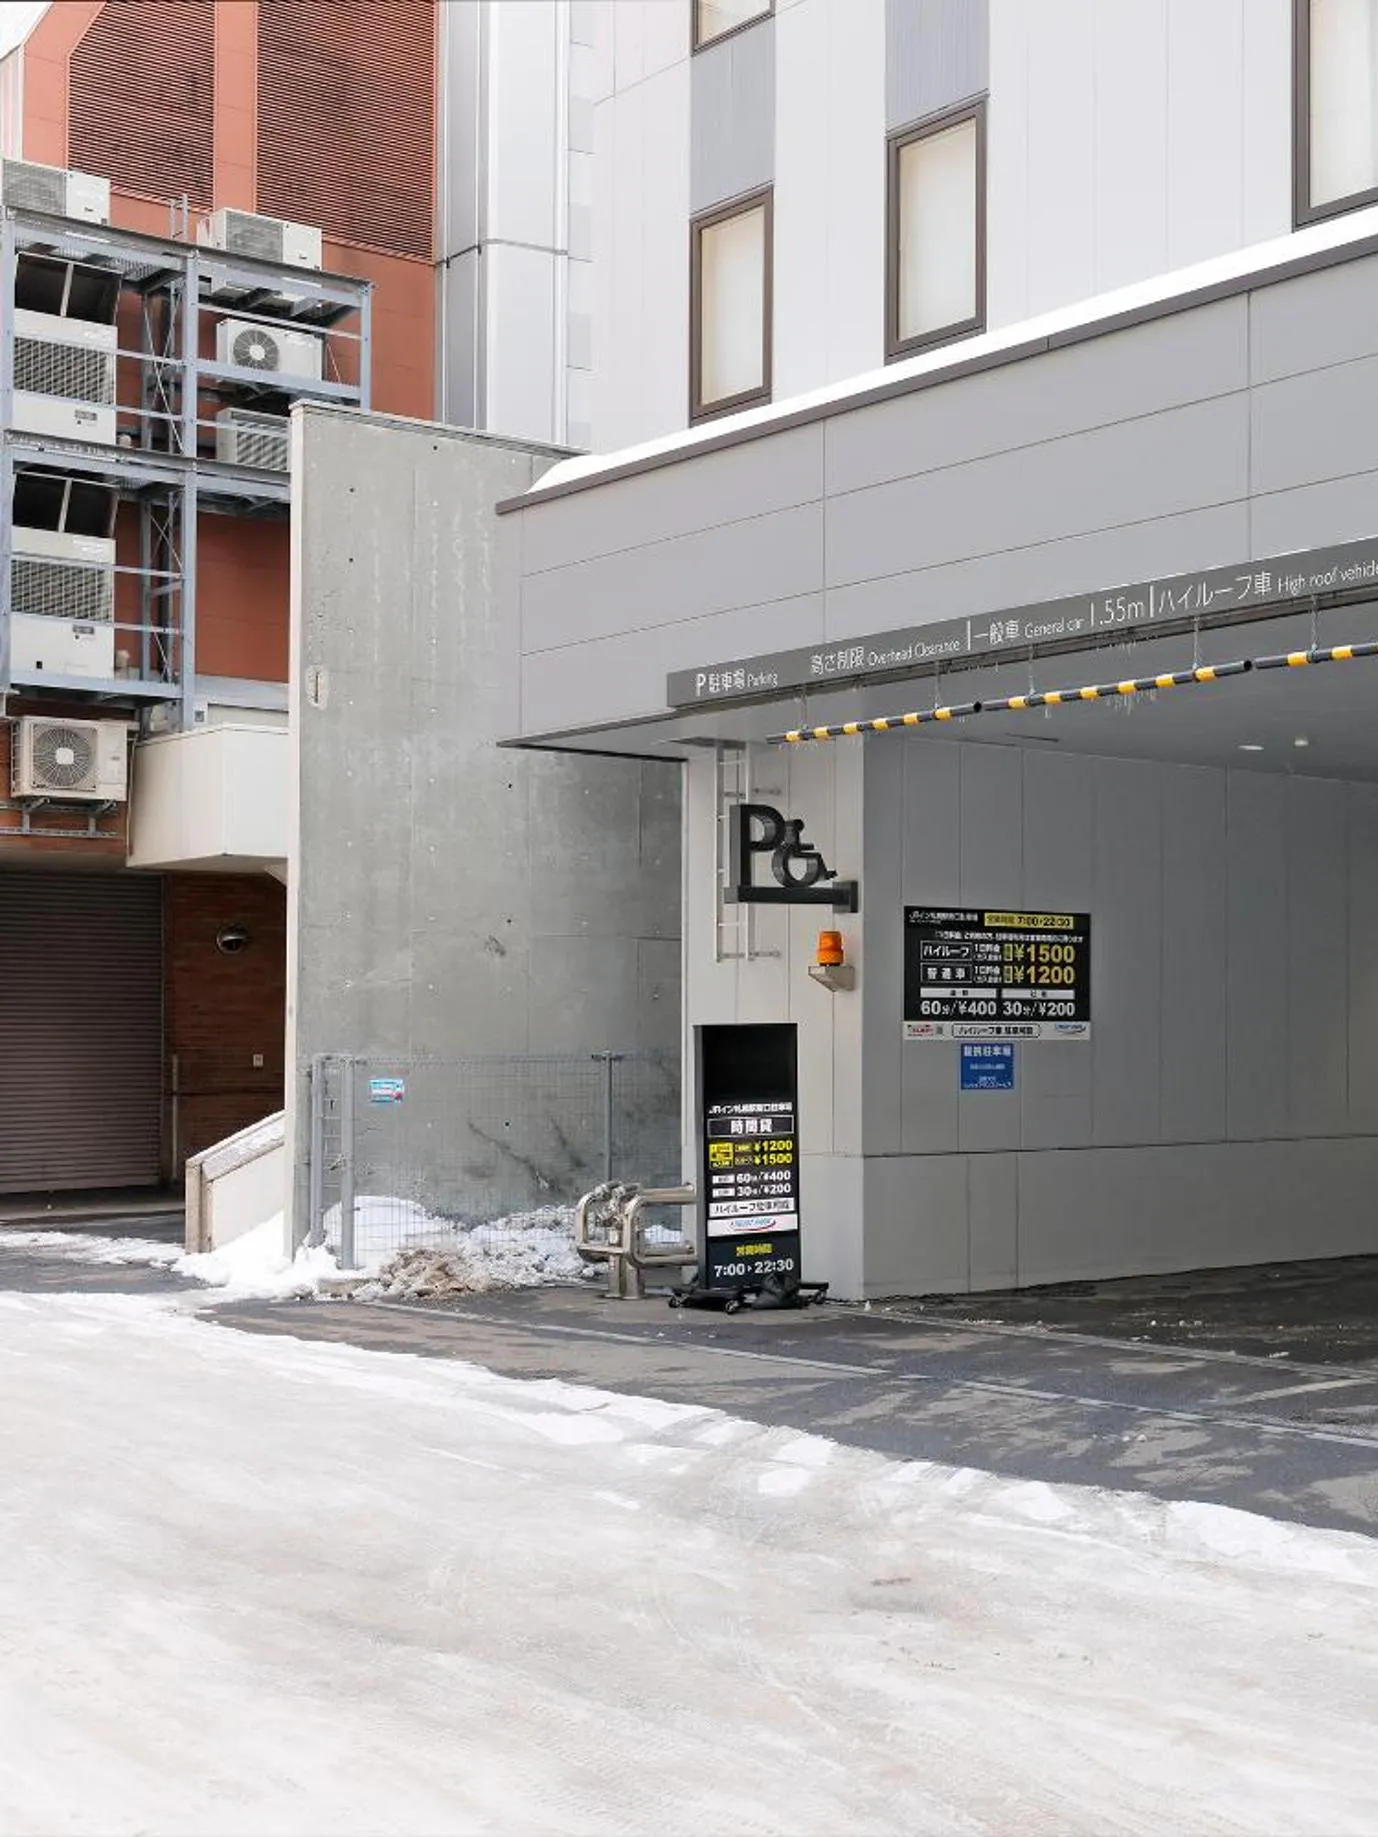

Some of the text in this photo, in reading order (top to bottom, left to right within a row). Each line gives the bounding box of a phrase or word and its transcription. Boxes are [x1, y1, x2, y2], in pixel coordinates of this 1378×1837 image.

[811, 646, 865, 676] 高さ制限
[972, 618, 1020, 645] 一般車
[1024, 617, 1065, 639] General
[1066, 617, 1085, 632] car
[1090, 596, 1146, 628] 1.55m
[1158, 571, 1273, 614] ハイルーフ車
[1277, 575, 1306, 596] High
[1309, 567, 1338, 588] roof
[923, 945, 970, 958] ハイルーフ
[1014, 943, 1075, 963] ¥1500
[1014, 964, 1075, 984] ¥1200
[730, 1118, 773, 1135] 時間貸
